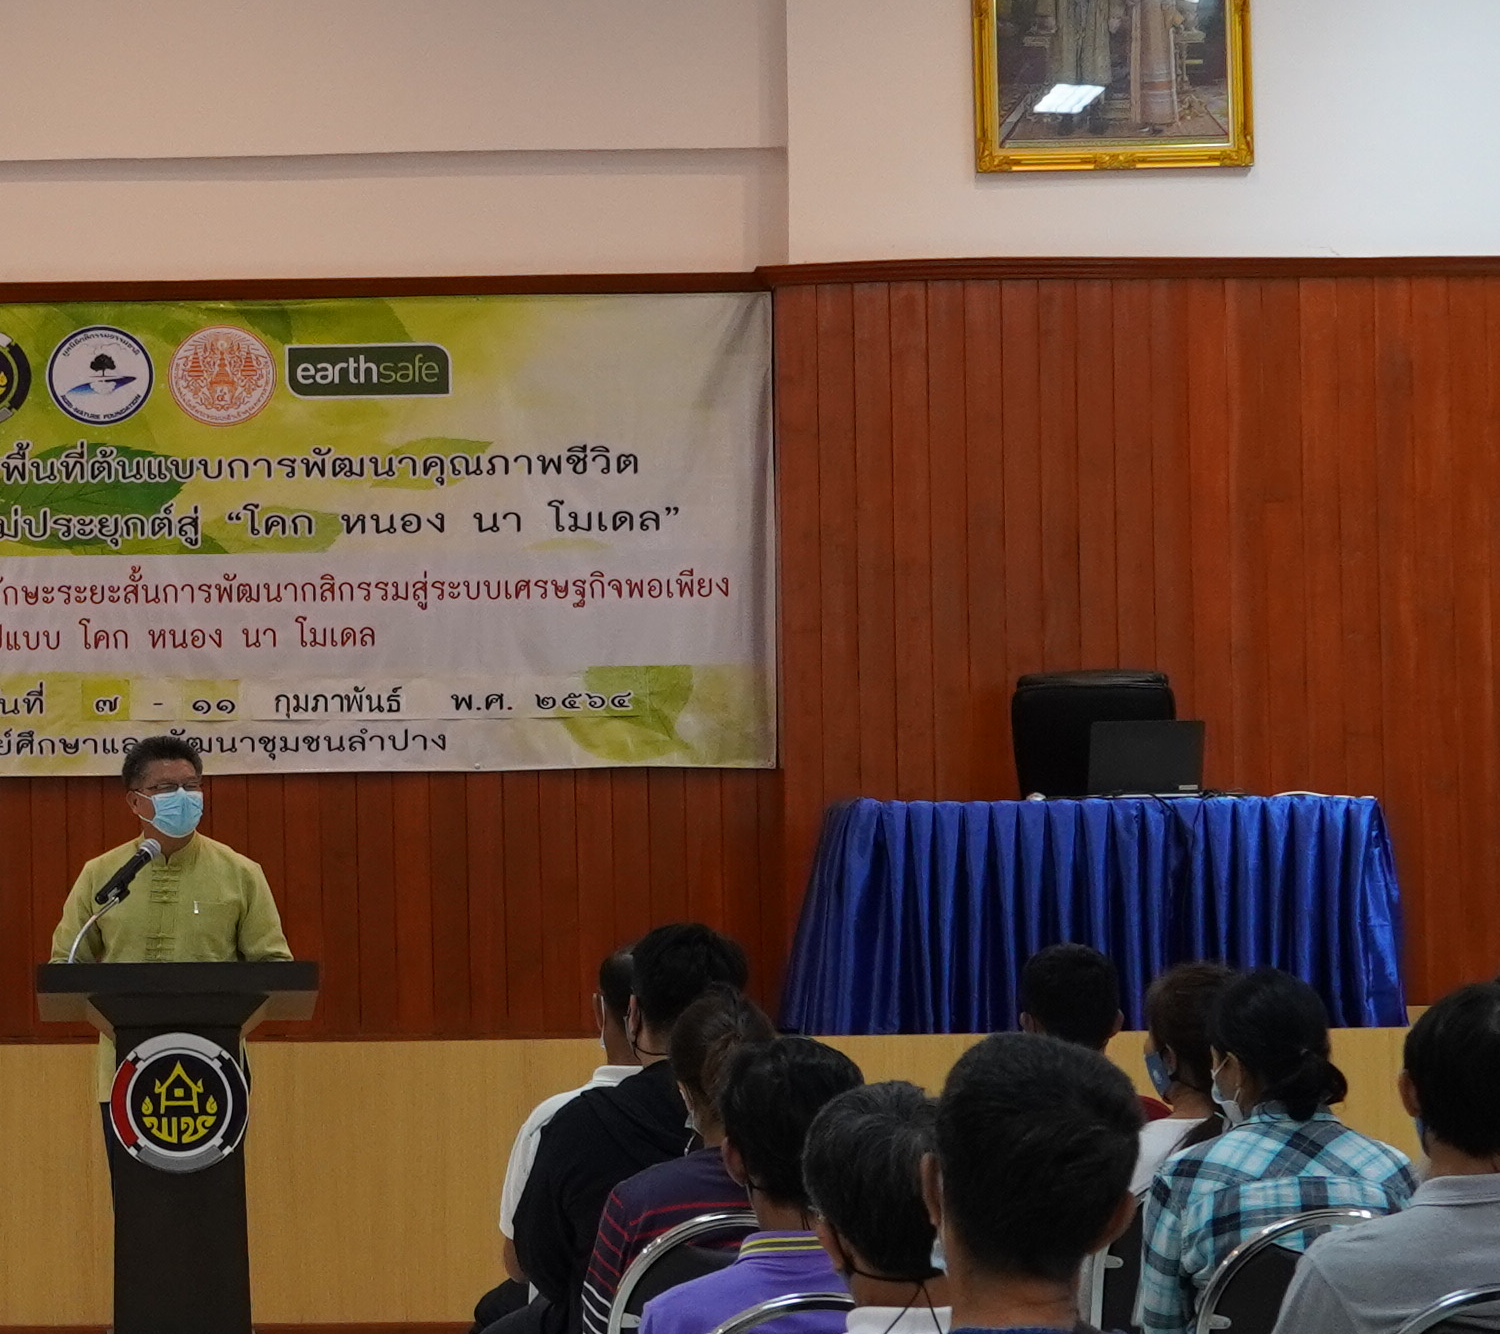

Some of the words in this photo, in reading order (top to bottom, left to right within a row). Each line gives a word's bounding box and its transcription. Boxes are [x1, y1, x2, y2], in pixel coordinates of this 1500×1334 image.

[296, 354, 440, 385] earthsafe
[341, 509, 446, 536] หนอง
[473, 510, 523, 534] นา
[78, 618, 129, 652] โคก
[148, 623, 223, 650] หนอง
[242, 624, 278, 649] นา
[295, 615, 376, 649] โมเดล
[95, 695, 120, 714] ๗
[191, 698, 237, 715] ๑๑
[274, 685, 403, 717] กุมภาพันธ์
[450, 689, 514, 713] พ.ศ.
[535, 691, 634, 711] ๒๕๖๔
